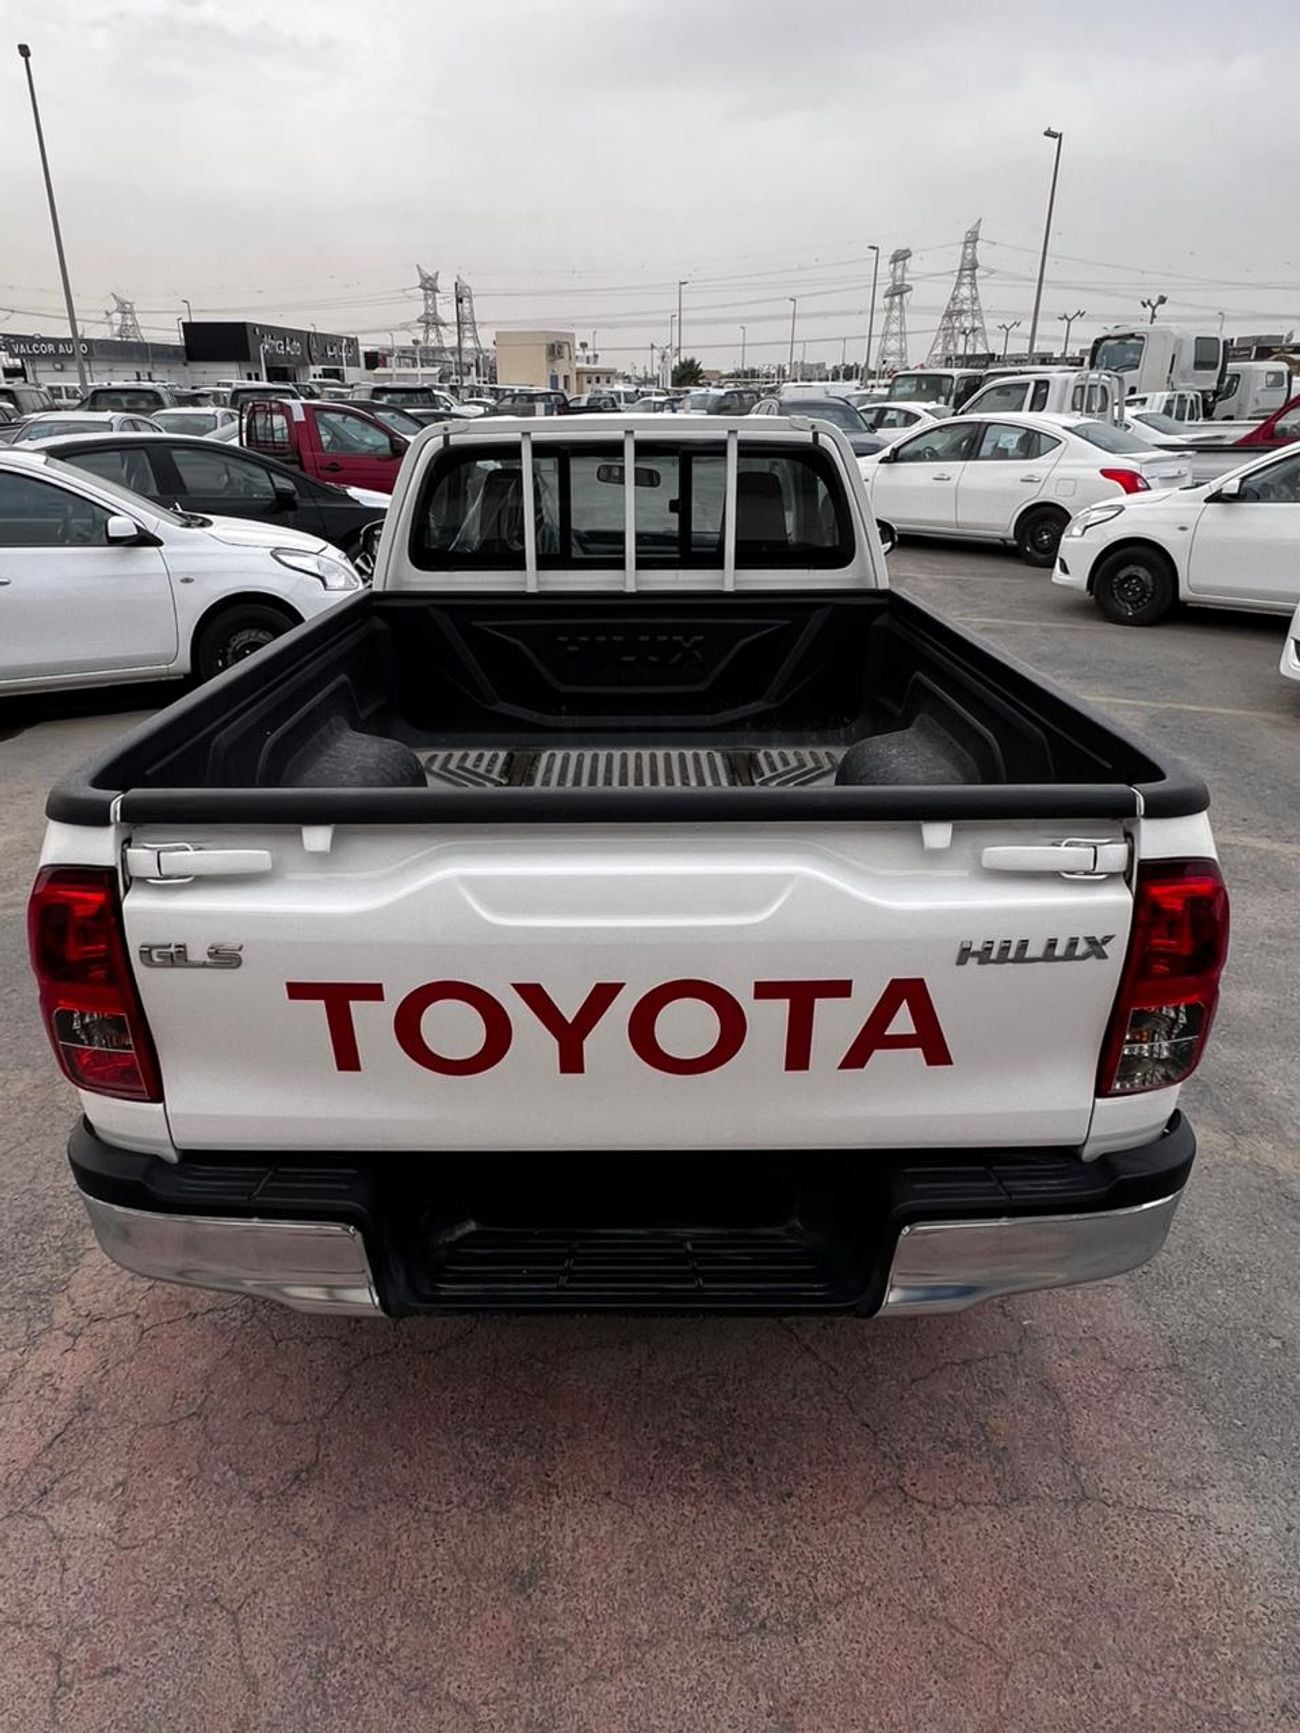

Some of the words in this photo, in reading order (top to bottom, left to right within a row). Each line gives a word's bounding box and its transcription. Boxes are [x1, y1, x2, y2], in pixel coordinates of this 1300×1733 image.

[12, 342, 56, 355] VALCOR
[59, 342, 88, 355] AUO
[138, 942, 244, 969] GLS
[955, 934, 1116, 966] HILUX
[285, 978, 954, 1076] TOYOTA
